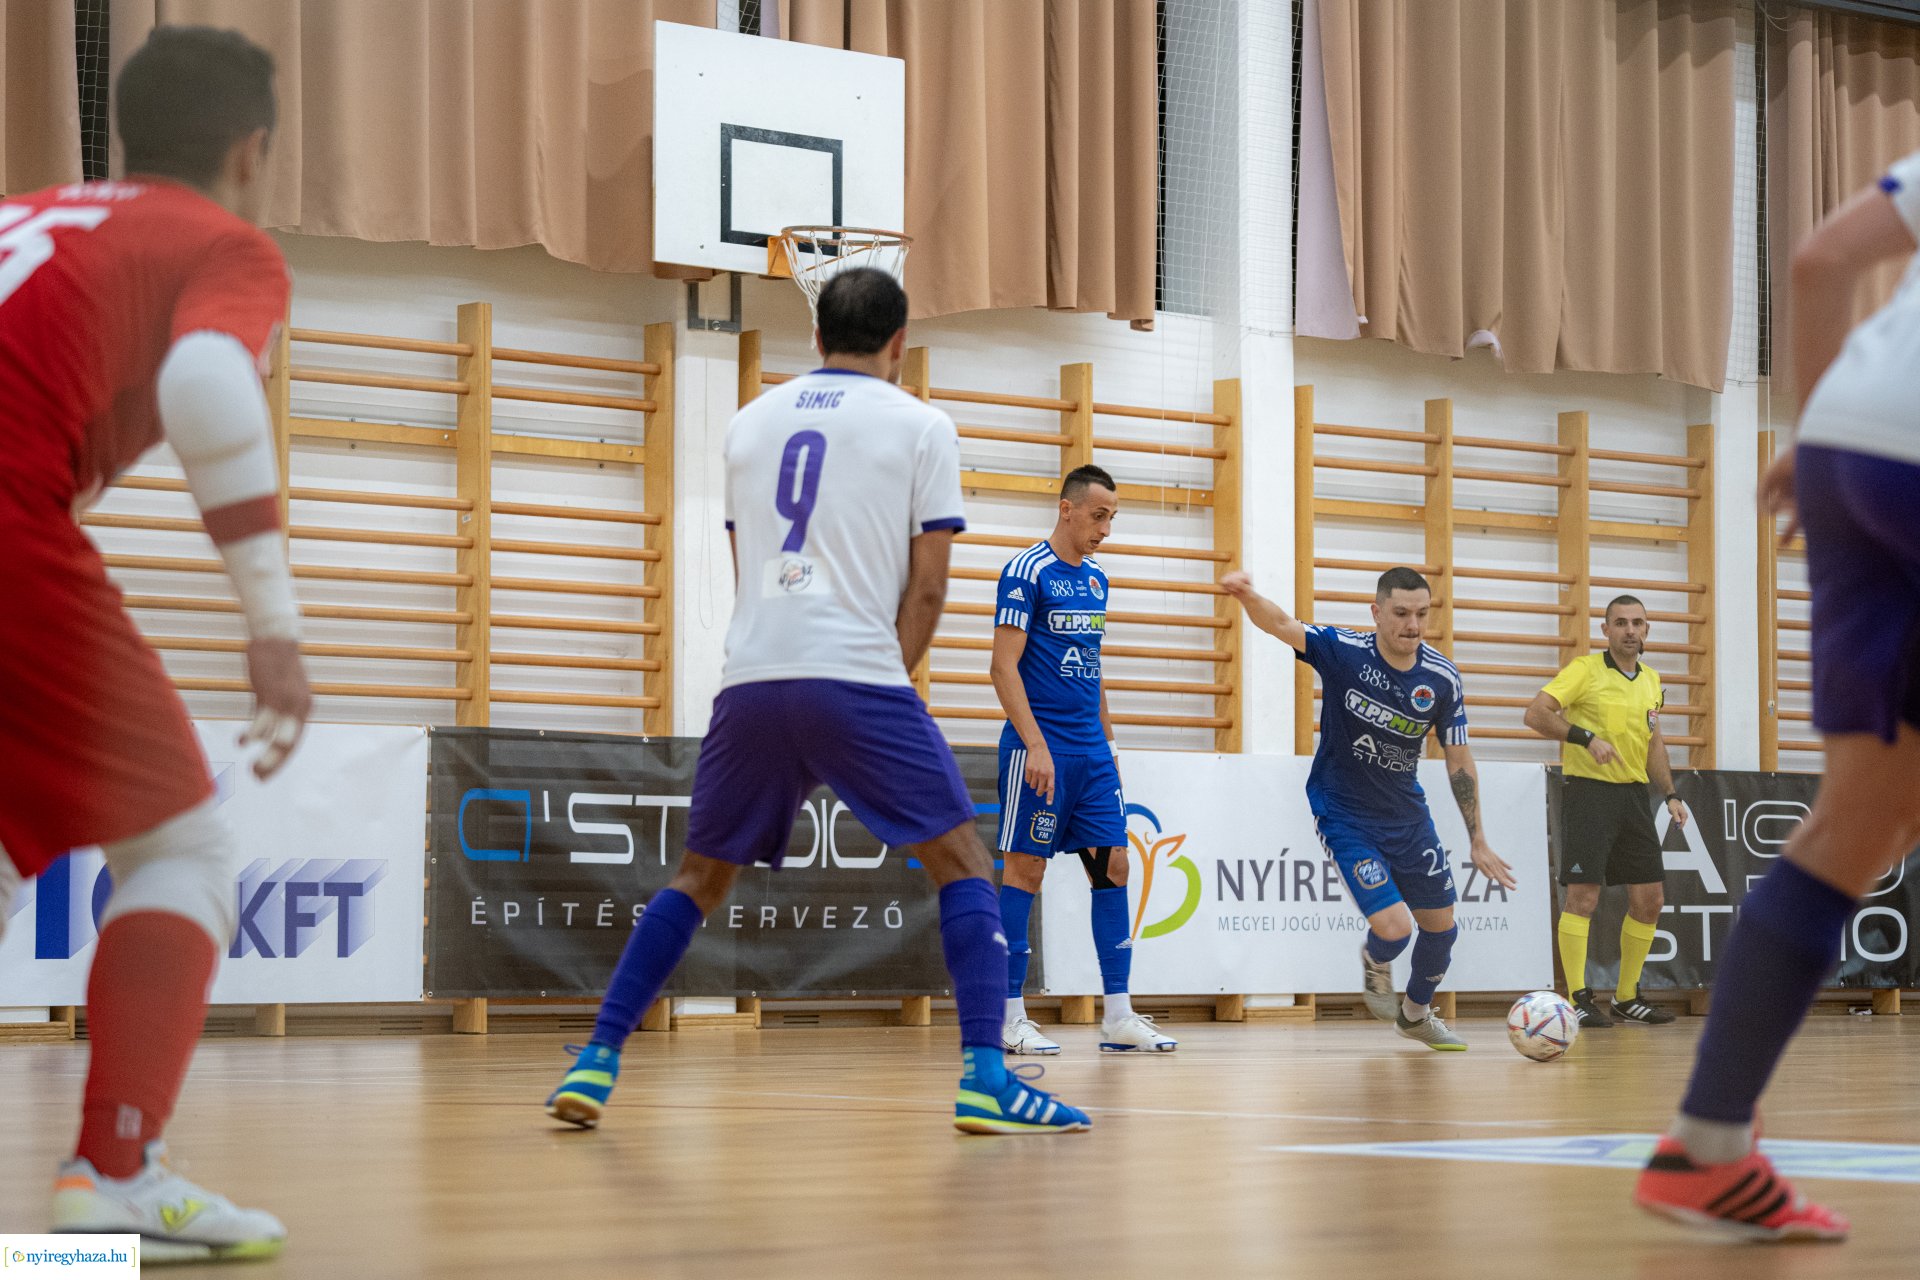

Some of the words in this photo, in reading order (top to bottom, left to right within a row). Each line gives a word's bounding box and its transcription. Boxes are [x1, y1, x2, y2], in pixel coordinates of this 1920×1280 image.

[775, 429, 828, 553] 9
[1049, 579, 1075, 597] 383
[1060, 665, 1100, 679] STUD
[229, 872, 375, 959] KFT
[702, 900, 904, 930] ERVEZŐ
[1217, 916, 1276, 932] MEGYEI
[1281, 914, 1320, 932] JOGÚ
[1328, 913, 1367, 932] VÁRO
[1645, 904, 1908, 963] STIO
